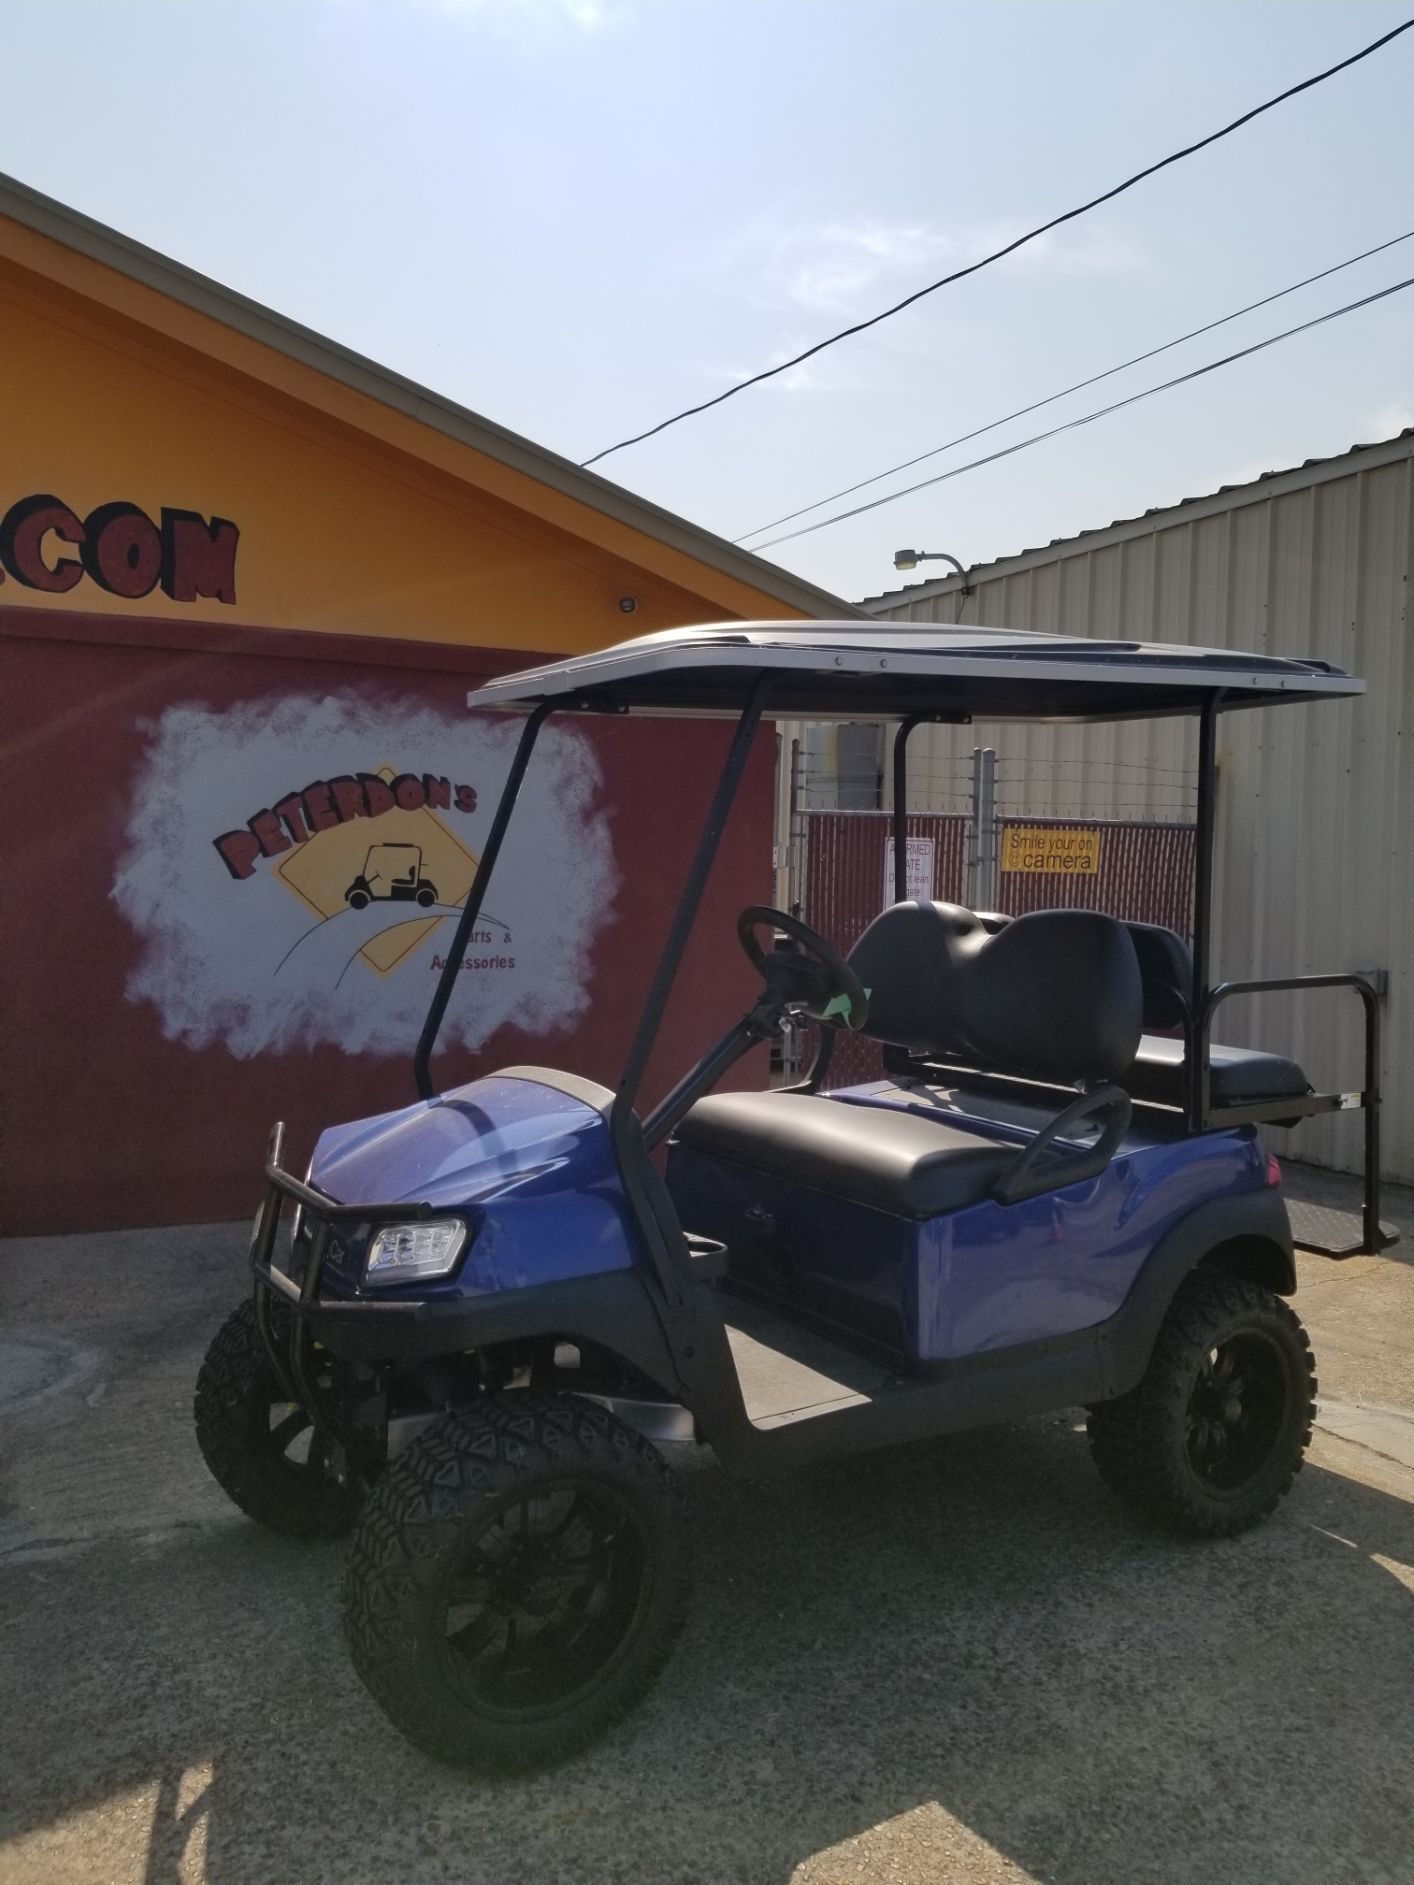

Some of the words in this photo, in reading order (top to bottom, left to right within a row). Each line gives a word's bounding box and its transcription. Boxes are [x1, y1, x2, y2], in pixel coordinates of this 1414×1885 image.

[0, 493, 240, 605] COM
[889, 842, 931, 856] ARMED
[1010, 833, 1045, 850] Smile
[1048, 837, 1075, 854] your
[1078, 838, 1093, 851] on
[1023, 852, 1092, 870] camera
[467, 930, 493, 944] arts
[503, 932, 512, 943] &
[430, 954, 516, 970] Acessories
